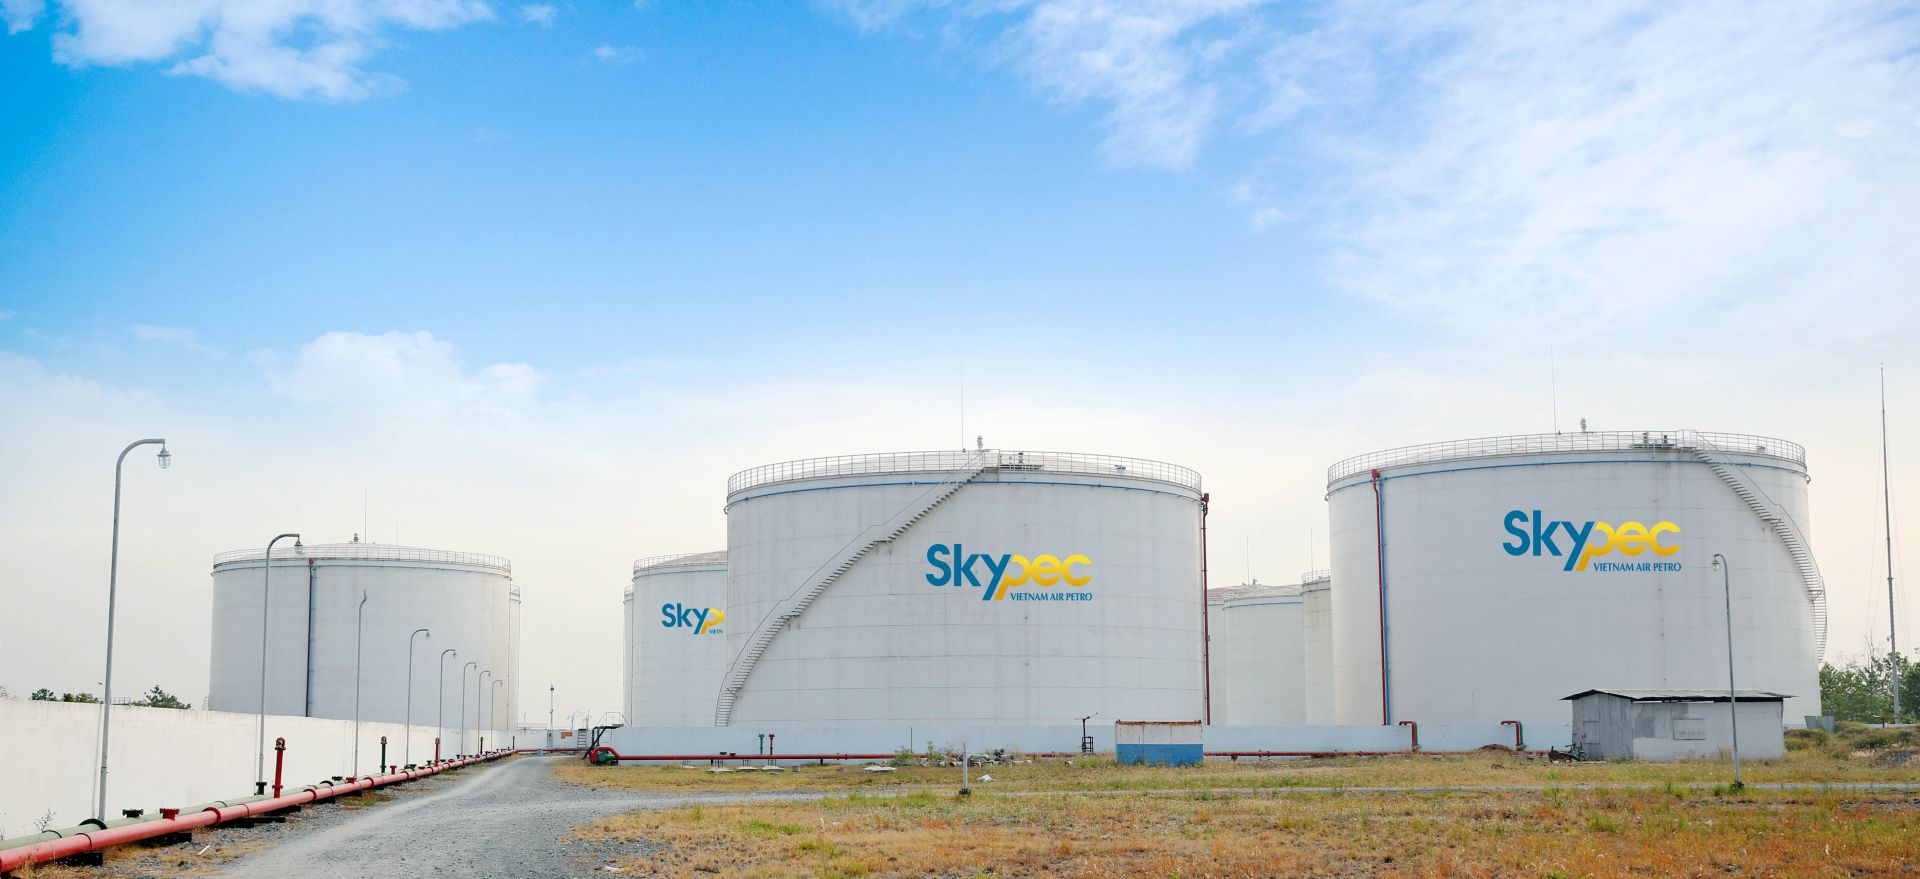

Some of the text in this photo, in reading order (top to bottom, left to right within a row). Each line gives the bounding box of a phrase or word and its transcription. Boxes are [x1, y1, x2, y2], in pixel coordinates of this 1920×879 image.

[1502, 510, 1681, 571] Skypec
[925, 543, 1093, 601] Skypec
[1593, 562, 1681, 572] VIETNAM AIR PETRO
[1010, 592, 1093, 601] VIETNAM AIR PETRO
[661, 602, 724, 635] Skyp
